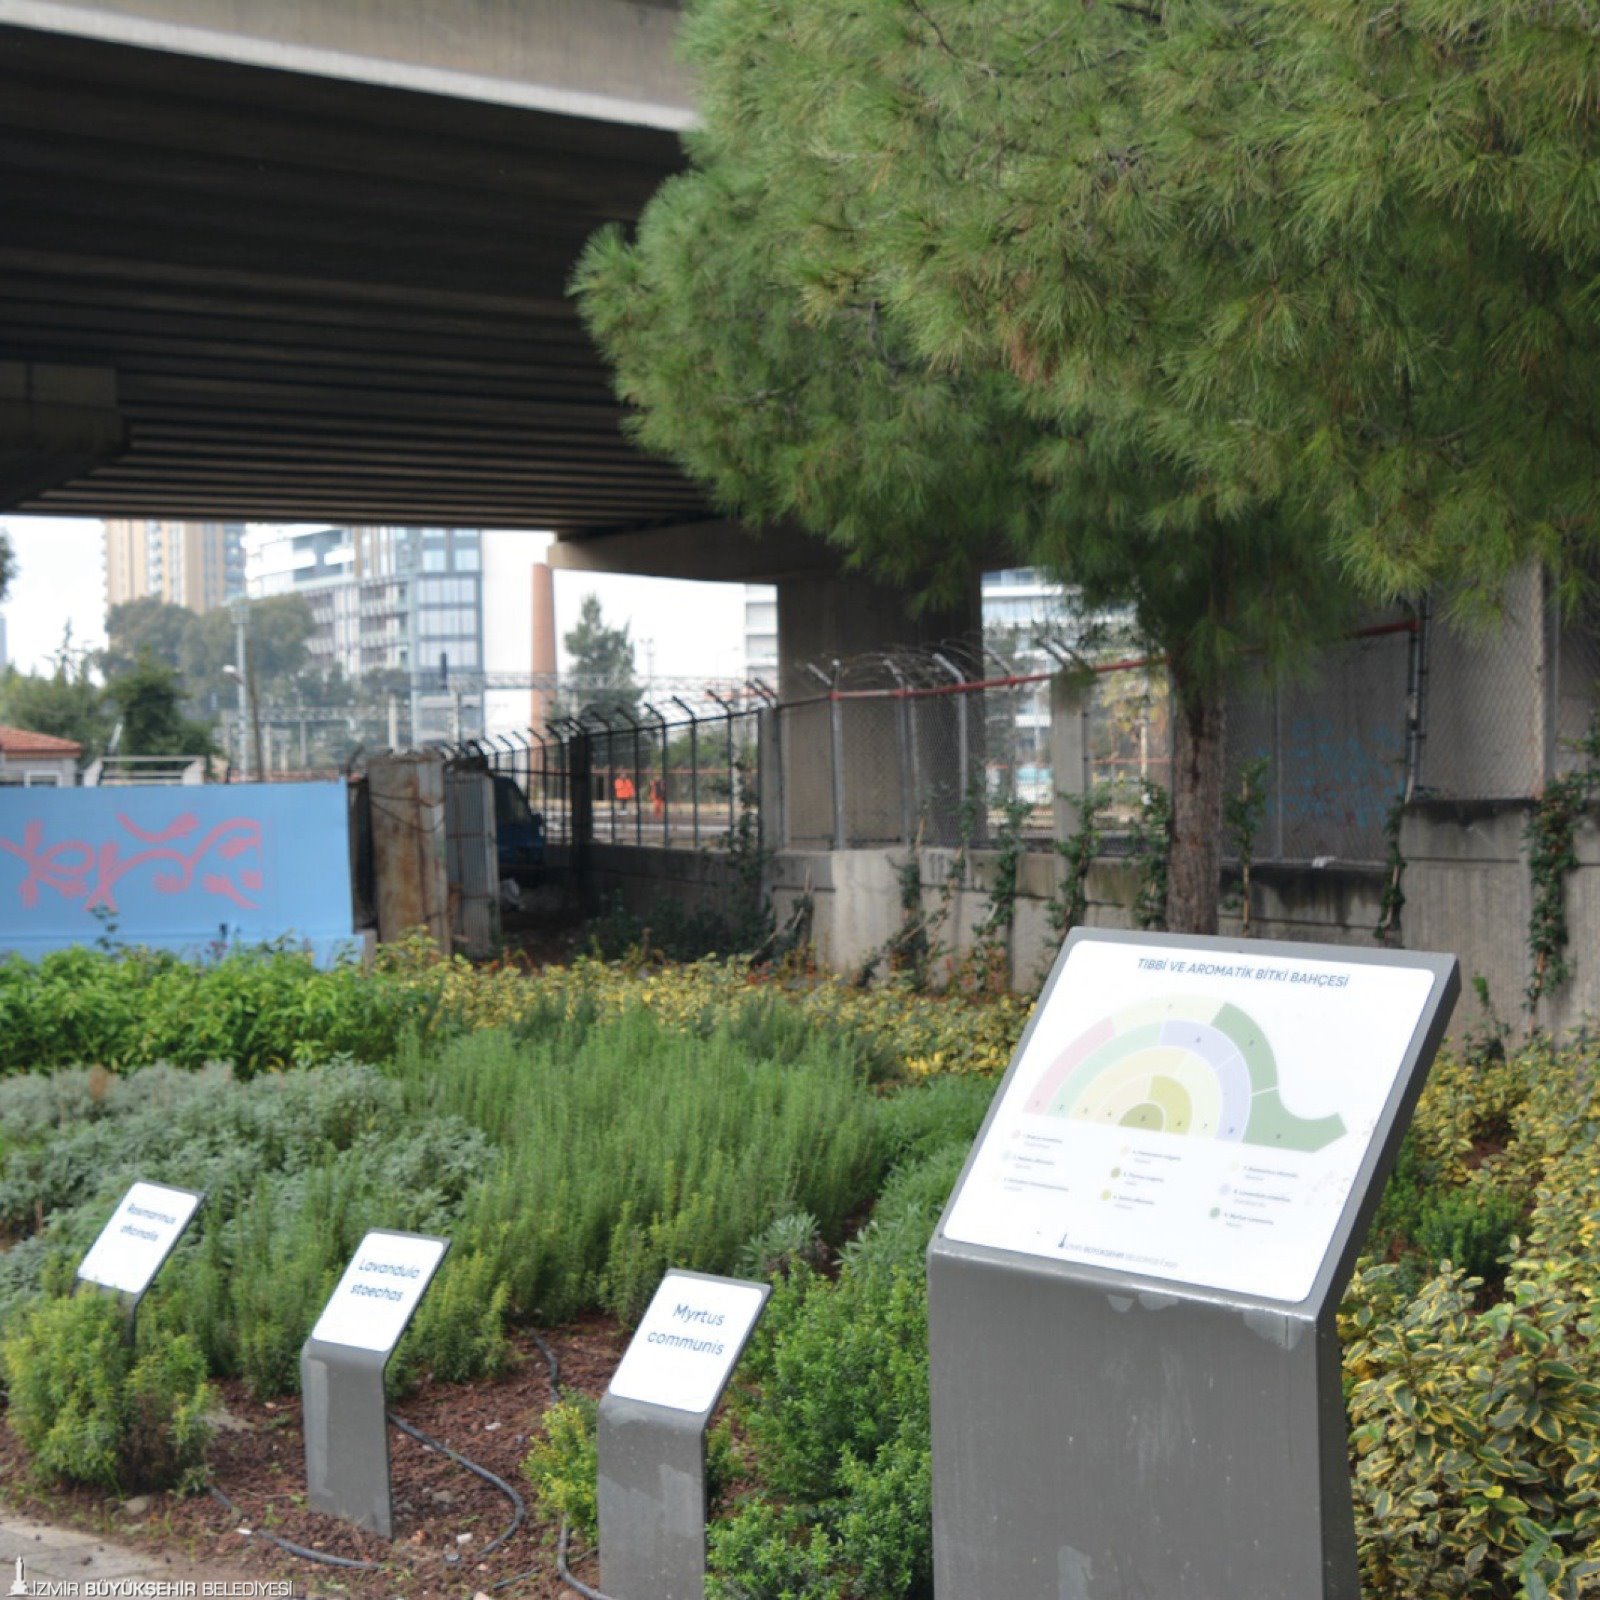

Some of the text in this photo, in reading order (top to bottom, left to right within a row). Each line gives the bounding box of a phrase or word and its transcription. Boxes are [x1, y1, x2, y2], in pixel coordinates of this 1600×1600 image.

[1170, 961, 1186, 973] VE
[1187, 963, 1254, 979] AROMATİK
[1255, 967, 1289, 981] BİTKİ
[1290, 972, 1349, 988] BAHÇESİ
[673, 1303, 725, 1326] Myrtus
[647, 1331, 725, 1355] communis
